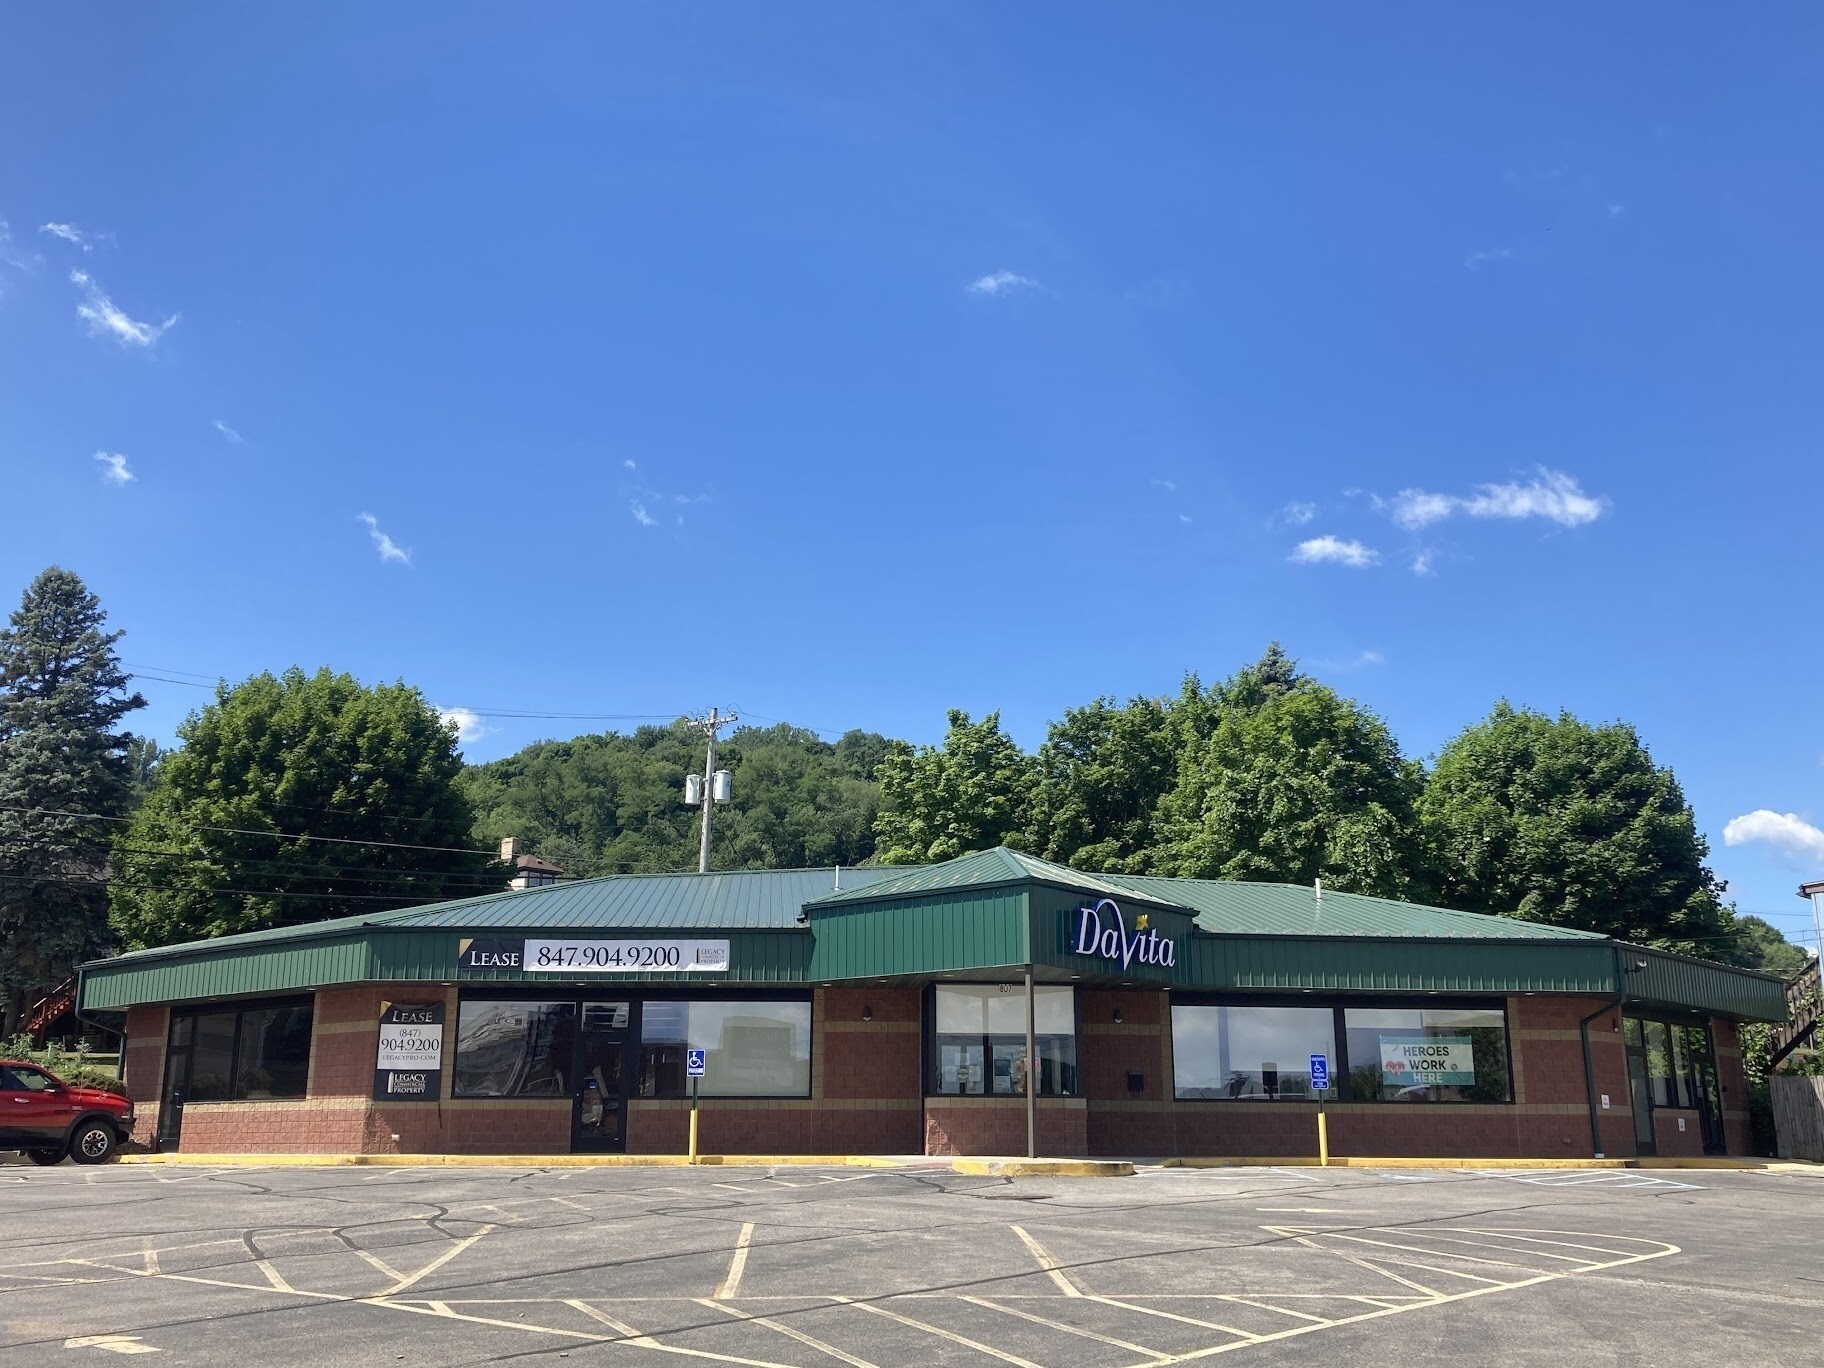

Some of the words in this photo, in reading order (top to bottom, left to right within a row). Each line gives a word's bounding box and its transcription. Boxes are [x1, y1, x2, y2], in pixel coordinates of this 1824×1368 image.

[1076, 898, 1176, 972] DaVita
[470, 950, 519, 966] LEASE
[537, 946, 680, 967] 847.904.9200
[999, 984, 1012, 993] 807
[392, 1010, 433, 1023] LEASE
[399, 1029, 421, 1038] (847)
[381, 1038, 440, 1051] 904.9200
[1403, 1046, 1450, 1057] HEROES
[1409, 1060, 1447, 1071] WORK
[1413, 1073, 1444, 1083] HERE
